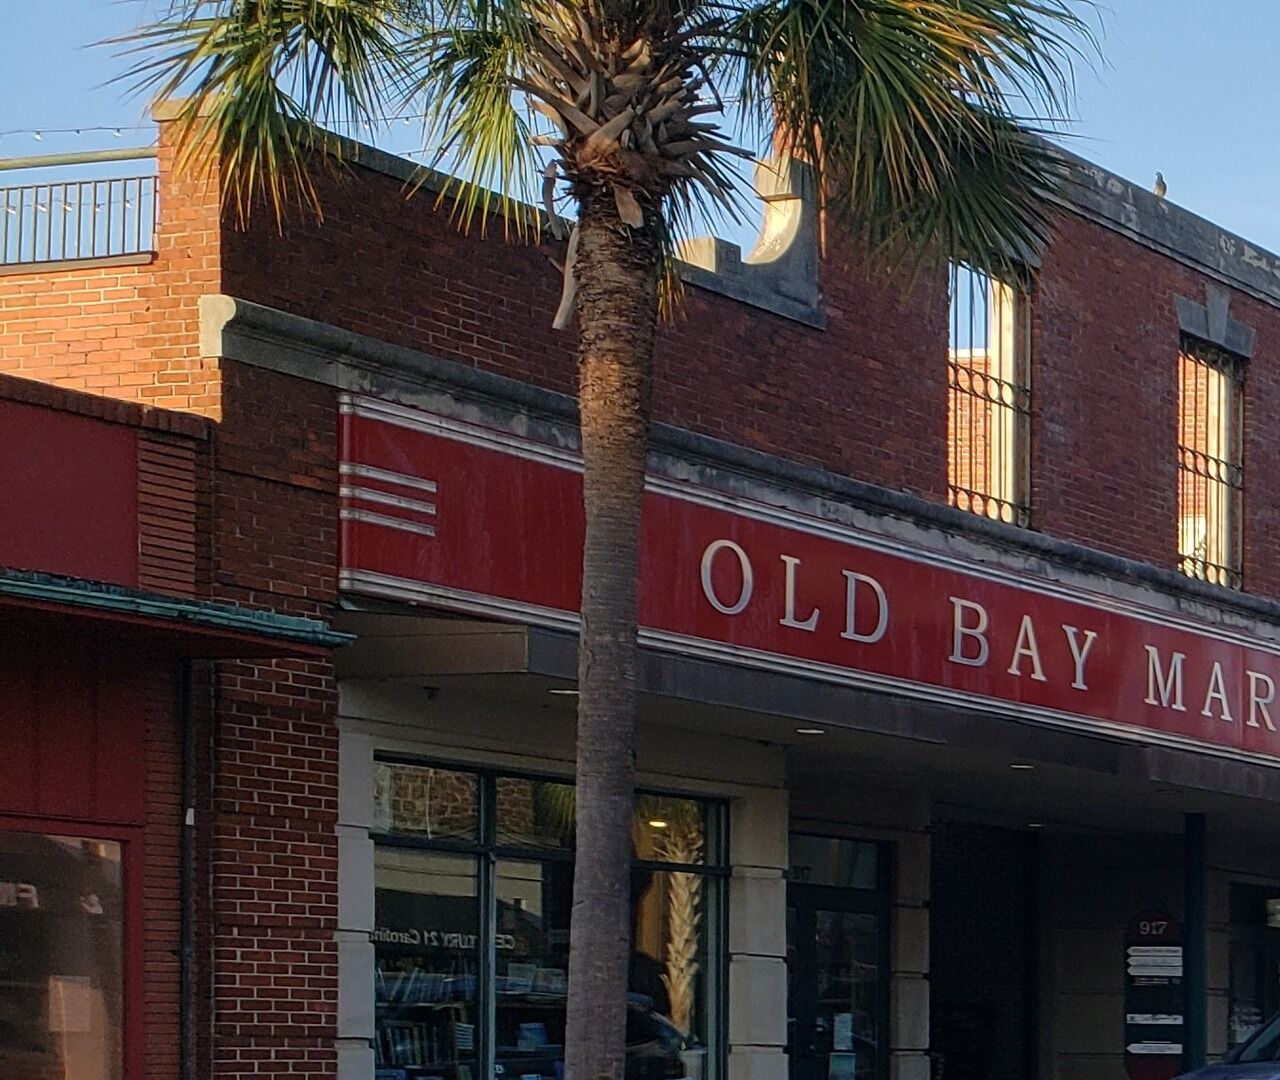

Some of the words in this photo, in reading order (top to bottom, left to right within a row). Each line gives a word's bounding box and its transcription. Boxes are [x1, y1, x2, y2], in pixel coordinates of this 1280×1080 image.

[700, 538, 889, 644] OLD
[948, 596, 1098, 691] BAY
[1139, 921, 1168, 935] 917
